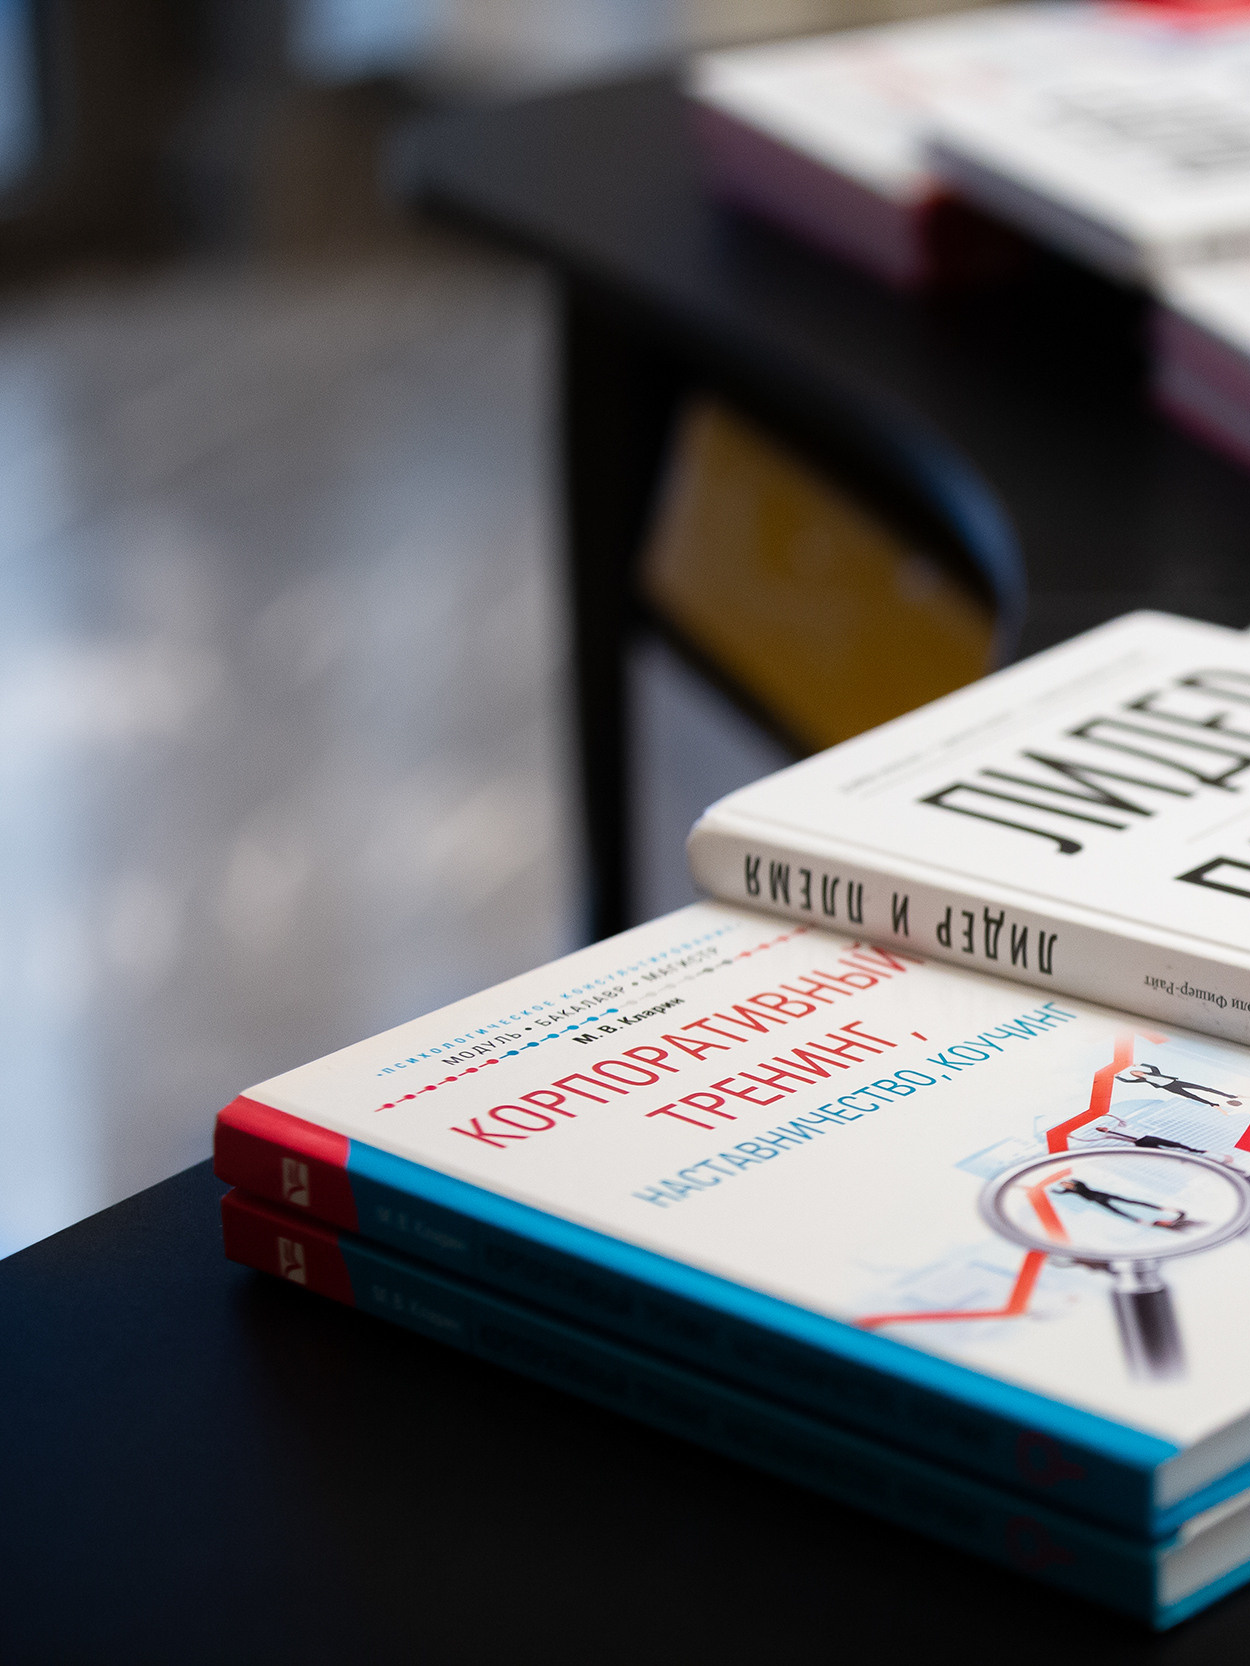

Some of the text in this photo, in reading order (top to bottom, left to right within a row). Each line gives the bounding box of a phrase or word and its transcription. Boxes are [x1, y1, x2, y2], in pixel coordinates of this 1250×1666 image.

[745, 854, 1059, 976] ЛИДЕР И ПЛЕМЯ
[442, 1030, 522, 1066] МОДУЛЬ
[535, 985, 627, 1027] БАКАЛАВР
[619, 996, 686, 1027] Кларин
[1144, 975, 1228, 1009] Фишер-Райт
[450, 940, 925, 1149] КОРПОРАТИВНЫЙ
[926, 1001, 1077, 1071] КОУЧИНГ
